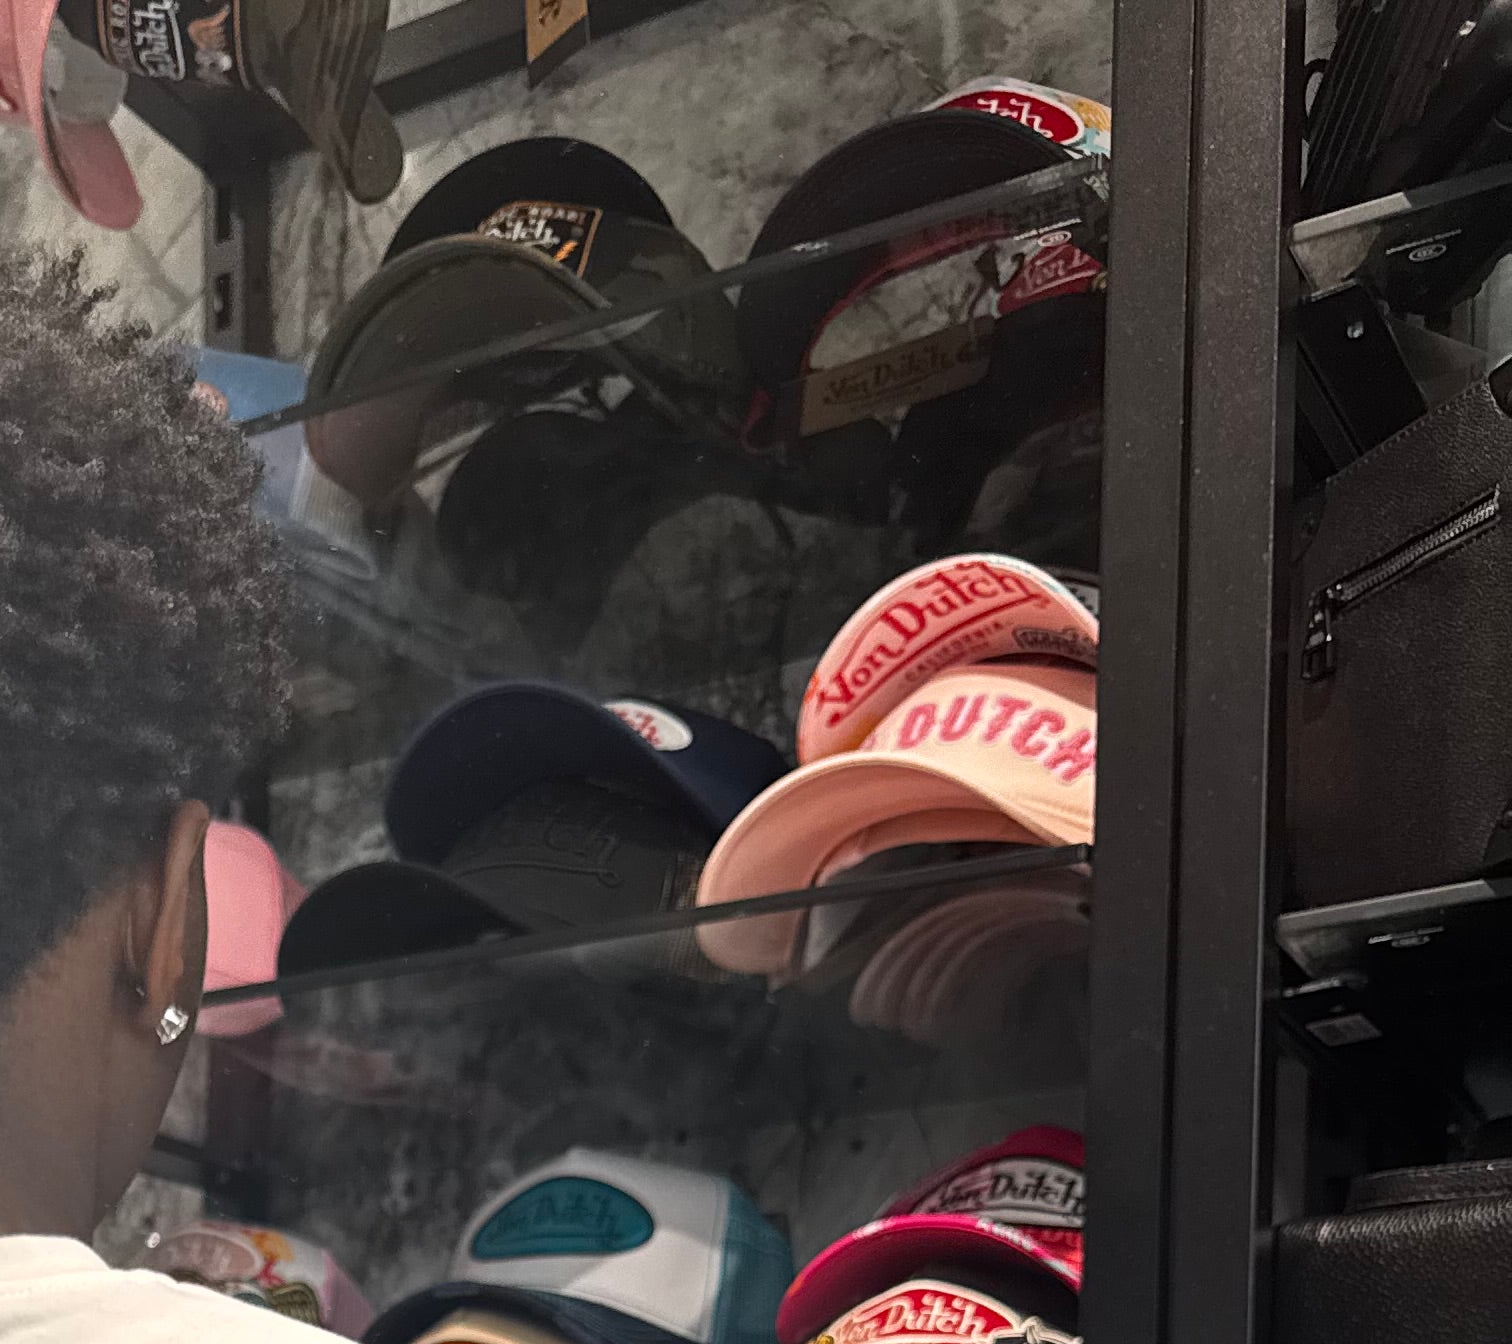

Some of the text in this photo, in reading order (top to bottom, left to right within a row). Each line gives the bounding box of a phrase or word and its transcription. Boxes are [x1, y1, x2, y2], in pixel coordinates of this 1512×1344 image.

[816, 560, 1050, 714] Von Dutch
[880, 1292, 991, 1344] Dutch
